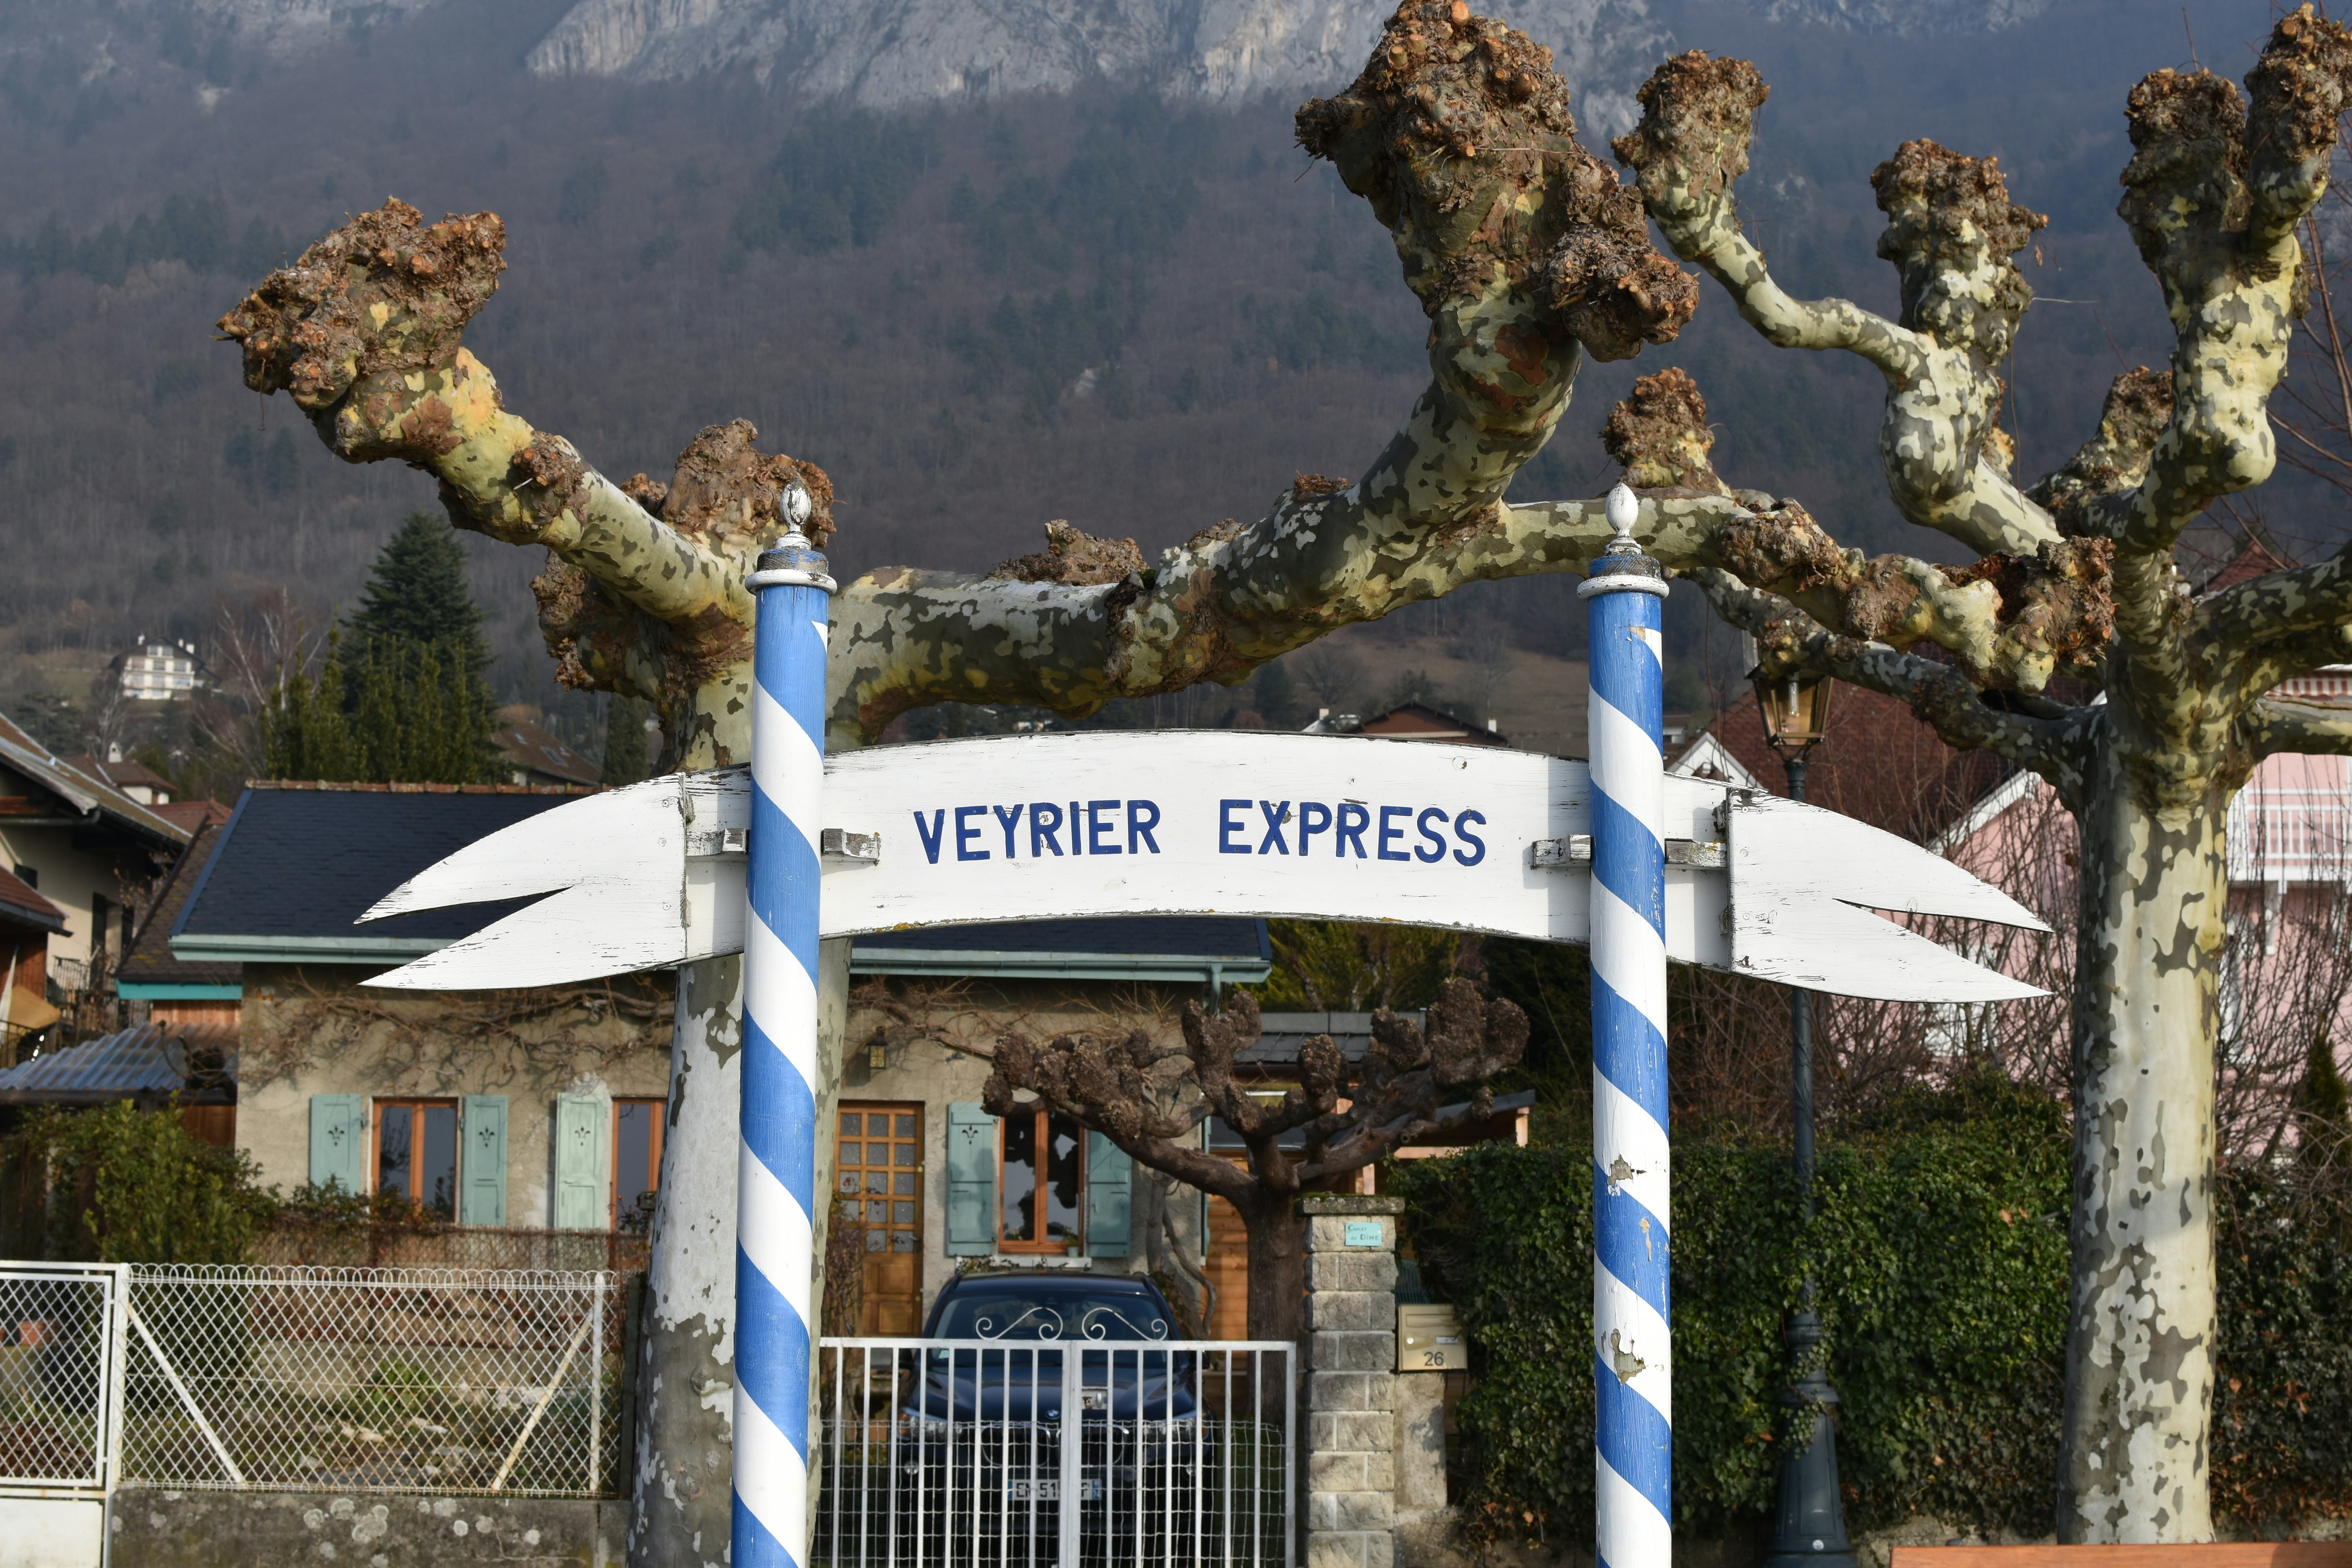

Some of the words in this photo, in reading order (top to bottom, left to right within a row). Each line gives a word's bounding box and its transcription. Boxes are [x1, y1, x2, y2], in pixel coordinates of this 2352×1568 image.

[914, 800, 1161, 864] VEYRIER
[1220, 799, 1486, 866] EXPRESS
[1424, 1352, 1444, 1366] 26
